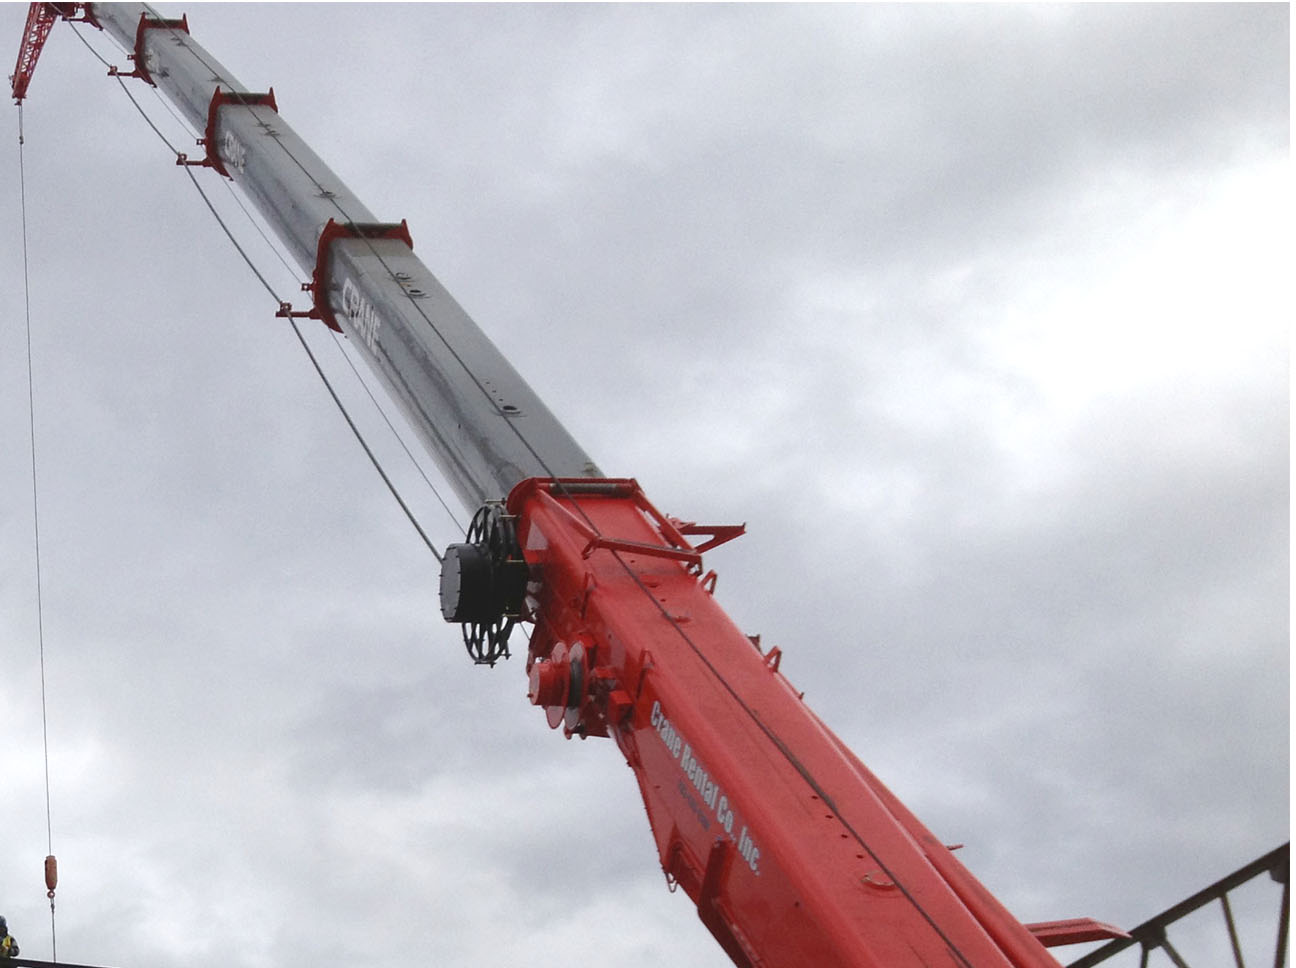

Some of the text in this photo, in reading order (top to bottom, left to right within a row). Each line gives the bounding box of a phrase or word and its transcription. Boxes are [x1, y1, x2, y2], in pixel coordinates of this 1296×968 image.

[651, 700, 681, 758] Crane
[680, 743, 720, 809] Rental
[738, 827, 761, 876] Inc.
